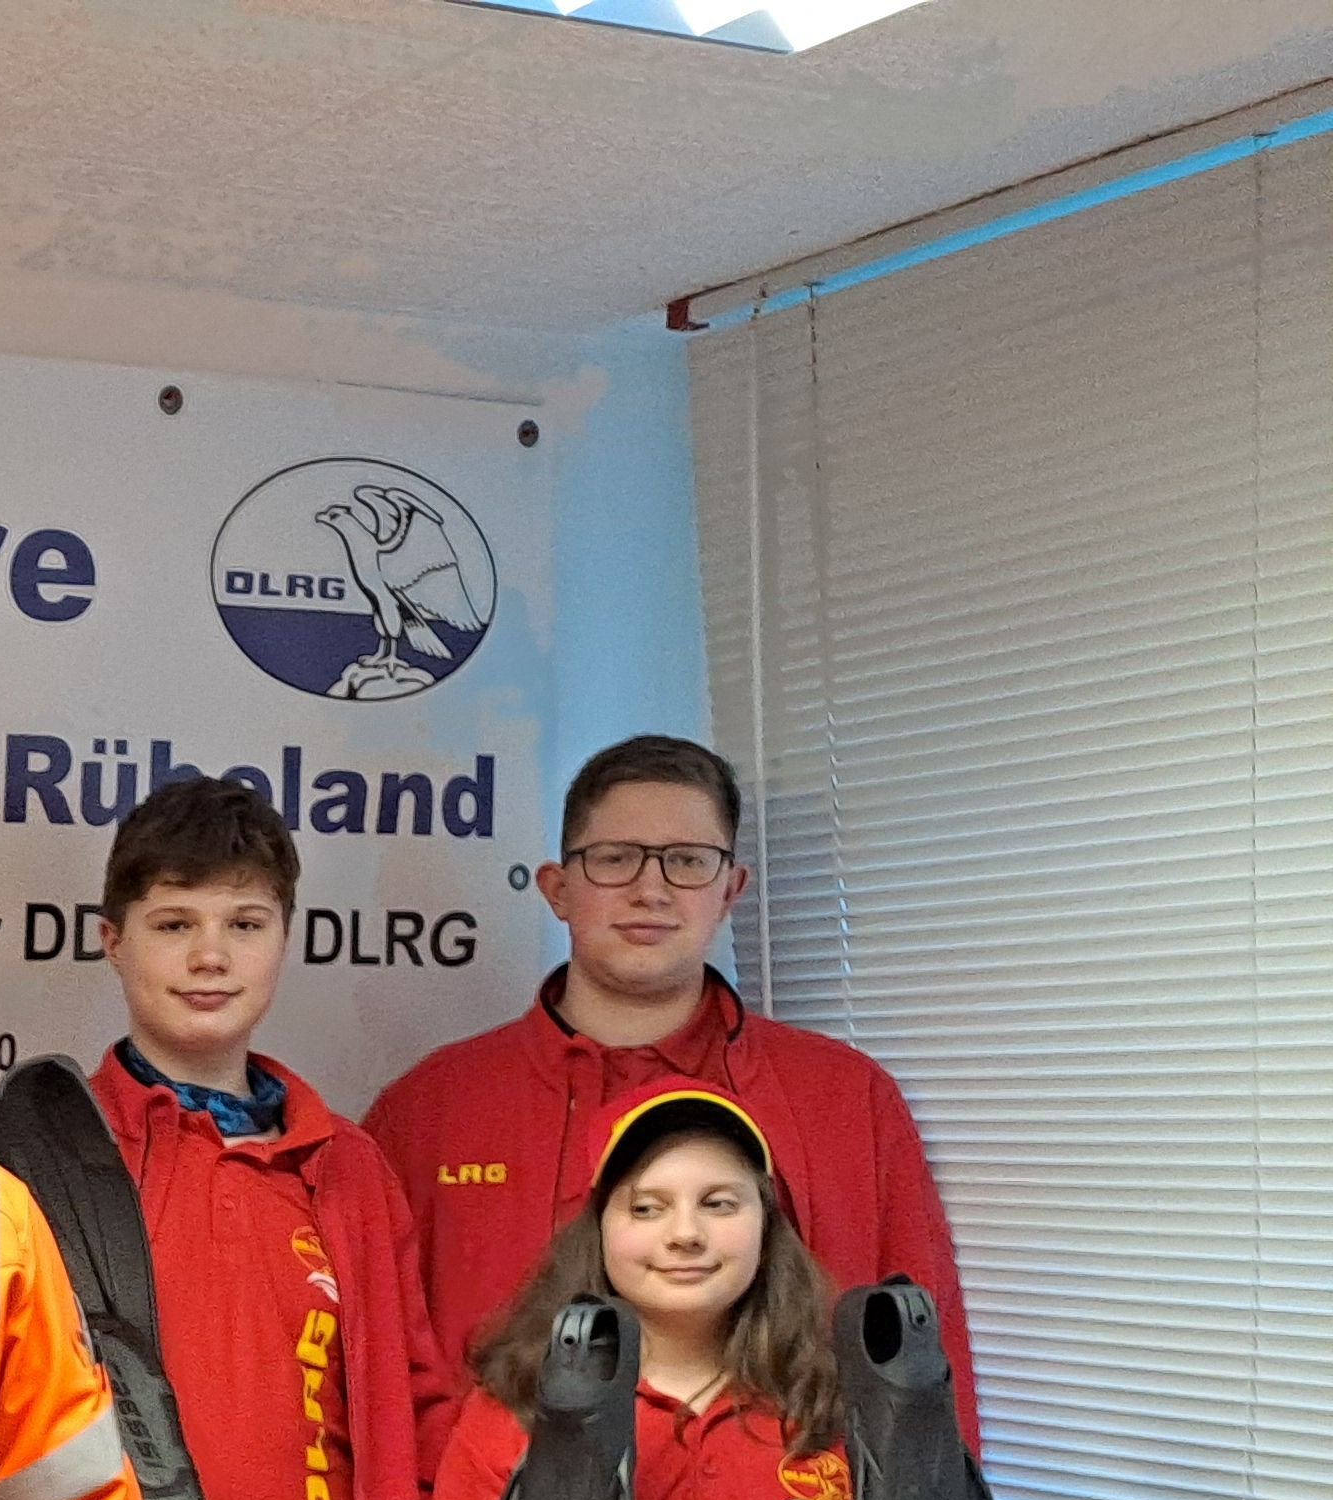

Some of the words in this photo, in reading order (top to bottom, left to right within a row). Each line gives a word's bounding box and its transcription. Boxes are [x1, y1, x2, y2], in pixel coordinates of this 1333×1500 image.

[224, 567, 347, 602] DLRG
[23, 902, 106, 962] DD
[303, 908, 479, 968] DLRG
[437, 1162, 508, 1185] LRG
